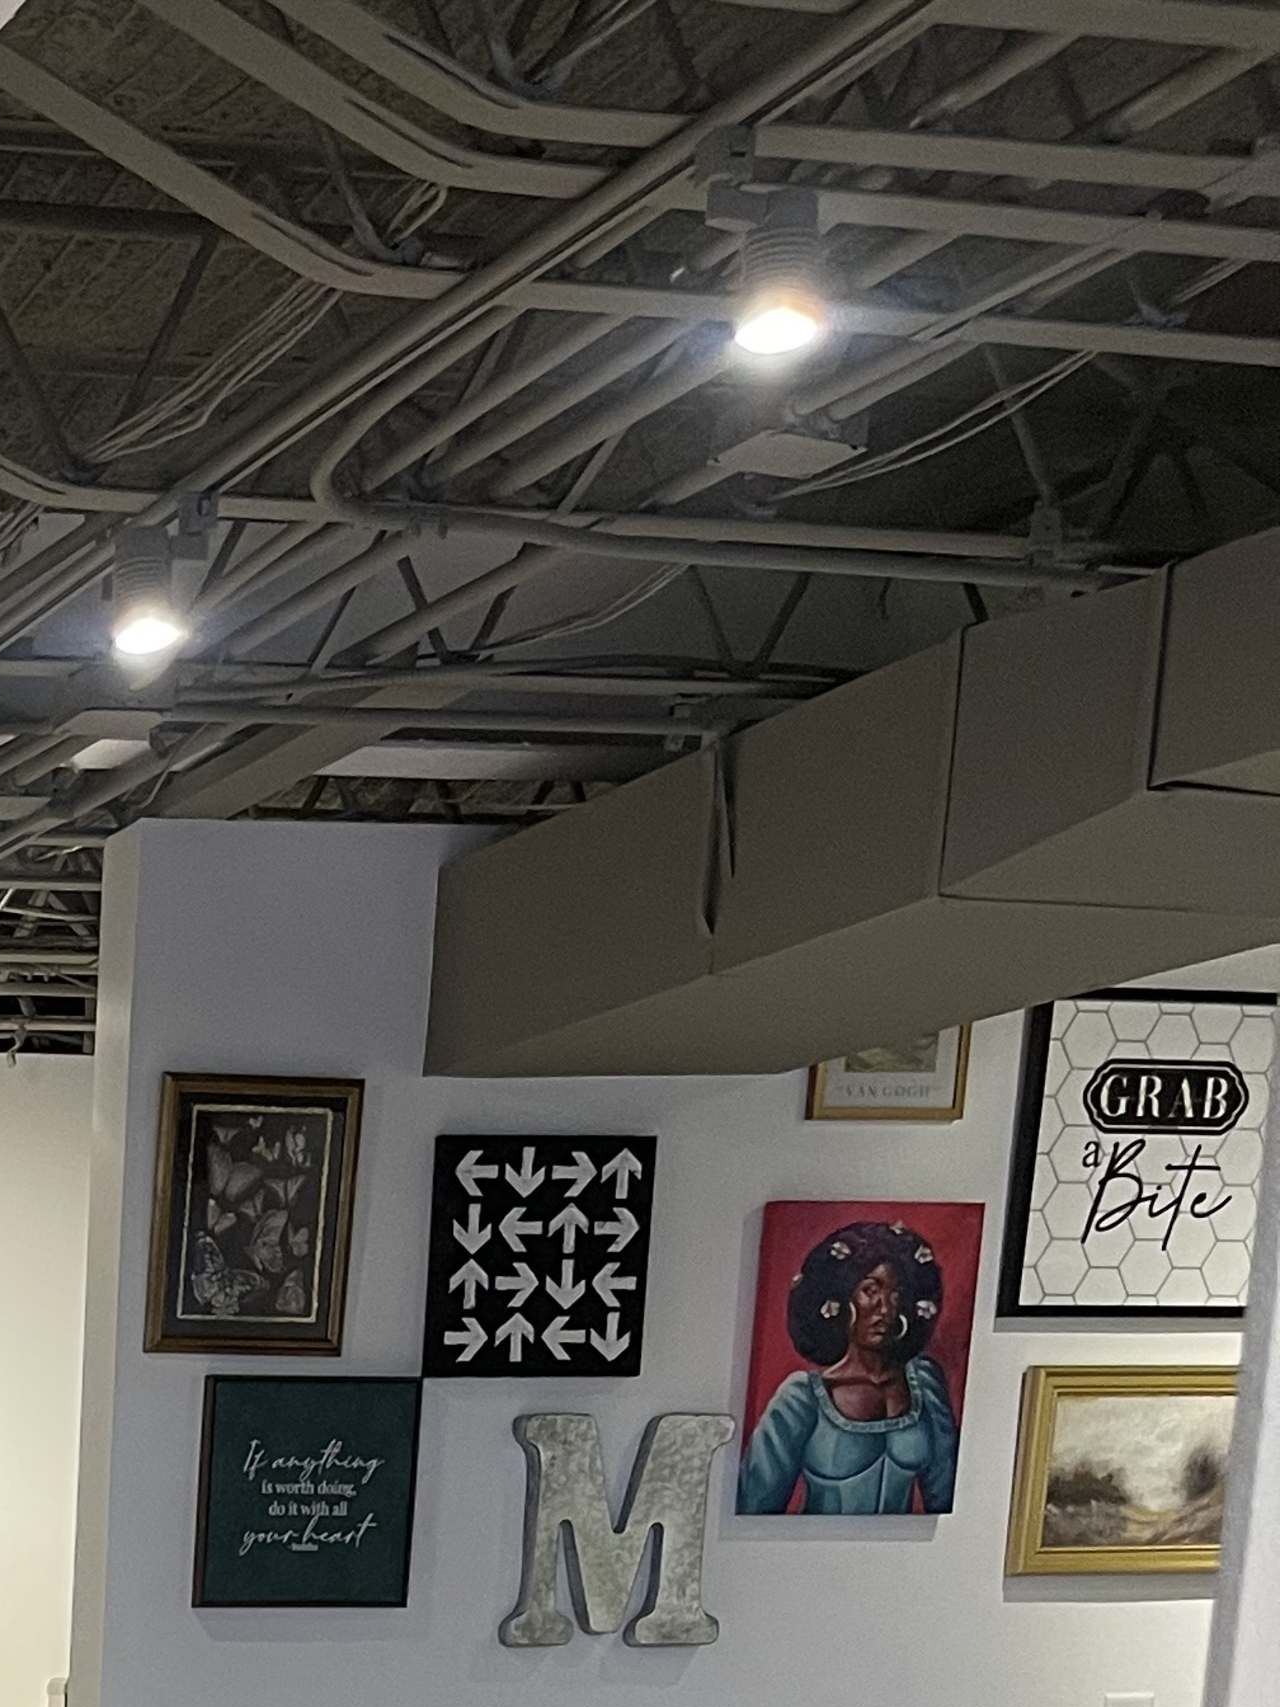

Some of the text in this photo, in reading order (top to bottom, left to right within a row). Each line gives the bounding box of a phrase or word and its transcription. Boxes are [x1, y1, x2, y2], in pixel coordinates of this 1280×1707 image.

[1100, 1073, 1228, 1119] GRAB
[1081, 1140, 1102, 1168] a
[1080, 1138, 1233, 1252] Bite
[271, 1438, 386, 1485] anything
[261, 1480, 273, 1494] is
[275, 1480, 314, 1495] worth
[268, 1500, 348, 1516] do it with all
[239, 1513, 378, 1556] your heart
[498, 1412, 736, 1648] M
